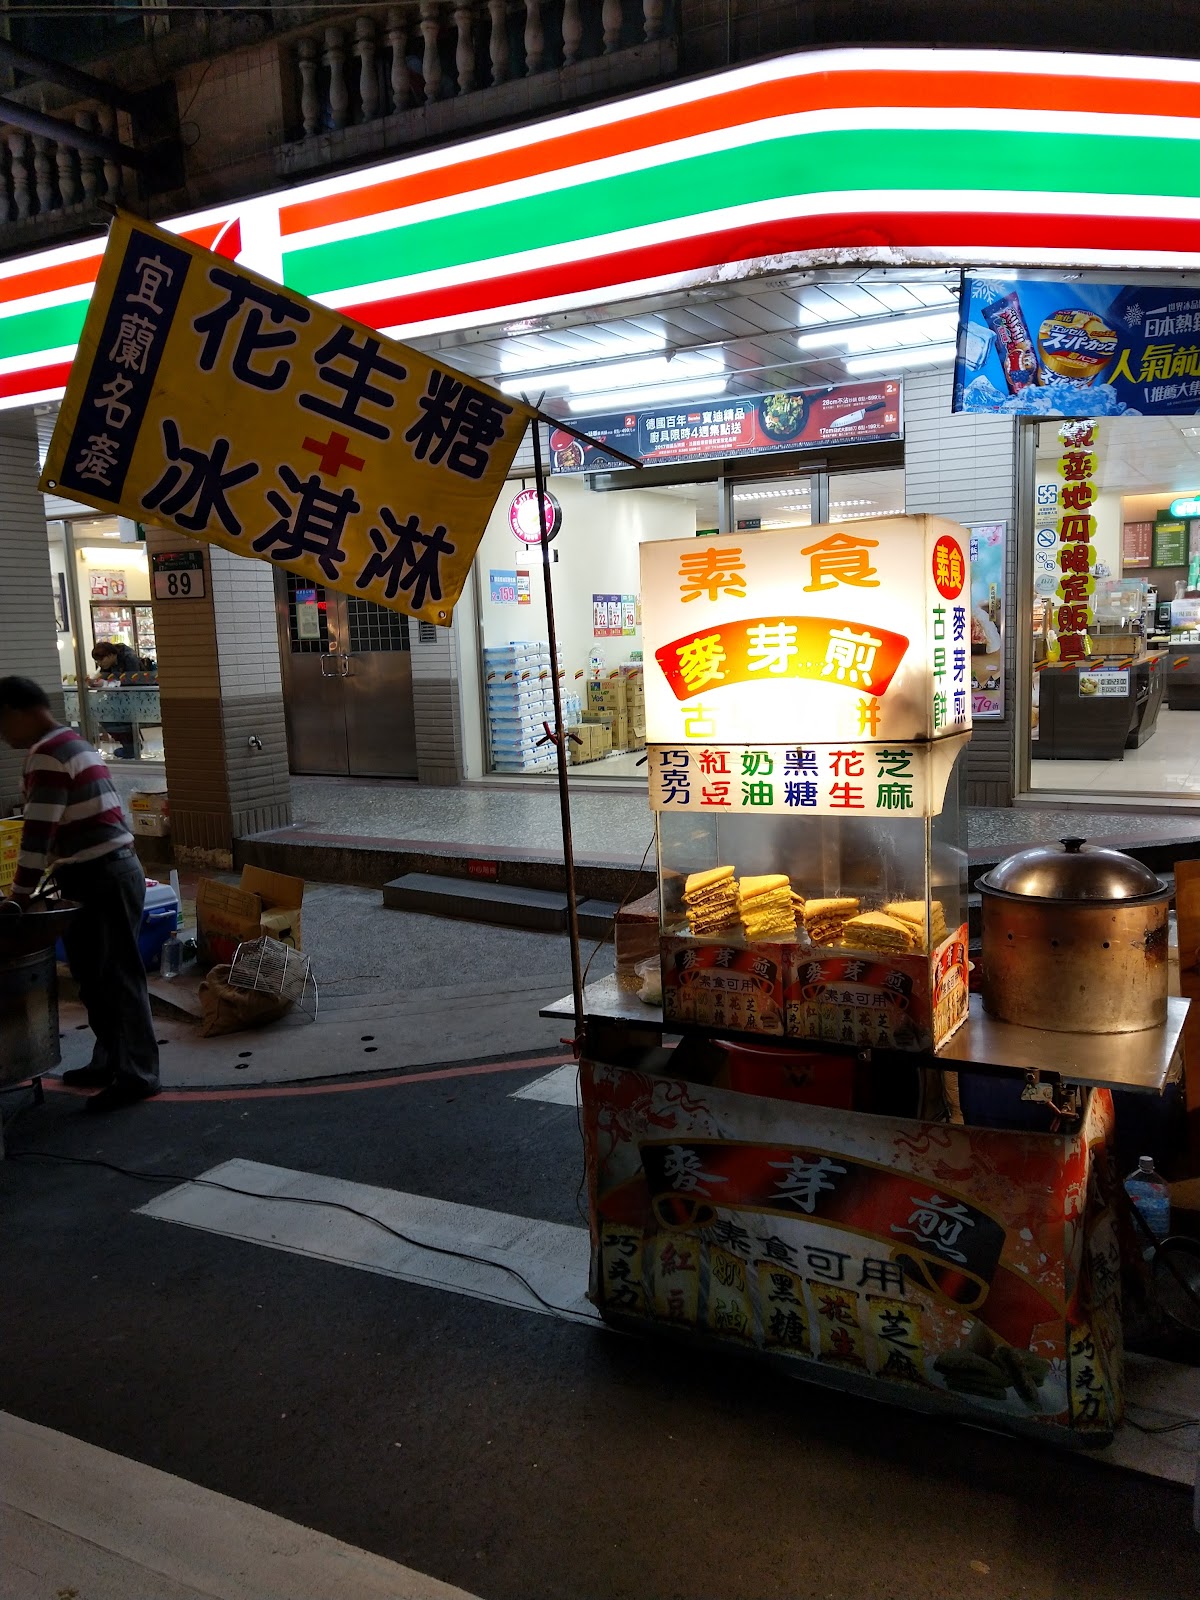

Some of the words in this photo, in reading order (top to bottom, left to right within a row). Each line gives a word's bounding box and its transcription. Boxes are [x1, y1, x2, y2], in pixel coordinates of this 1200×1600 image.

[75, 255, 174, 487] 宜蘭名產
[193, 266, 514, 480] 花生糖
[646, 415, 687, 430] 德國百年
[140, 419, 456, 611] 冰淇淋
[168, 572, 191, 595] 89
[500, 587, 514, 601] 159
[678, 533, 880, 603] 素食
[936, 544, 962, 590] 素食
[676, 622, 882, 691] 麥芽煎
[933, 603, 947, 729] 古早餅
[953, 605, 966, 724] 麥芽煎
[659, 749, 691, 805] 巧克力
[700, 749, 731, 807] 紅豆
[740, 750, 773, 807] 奶油
[783, 748, 818, 807] 黑糖
[828, 750, 865, 809] 花生
[876, 750, 914, 810] 芝麻
[825, 989, 887, 1007] 素食可用
[664, 1145, 976, 1264] 麥芽煎
[603, 1234, 642, 1308] 巧克力
[660, 1241, 697, 1318] 紅豆
[714, 1219, 905, 1295] 素食可用
[768, 1272, 806, 1346] 黑糖
[1073, 1331, 1103, 1418] 巧克力
